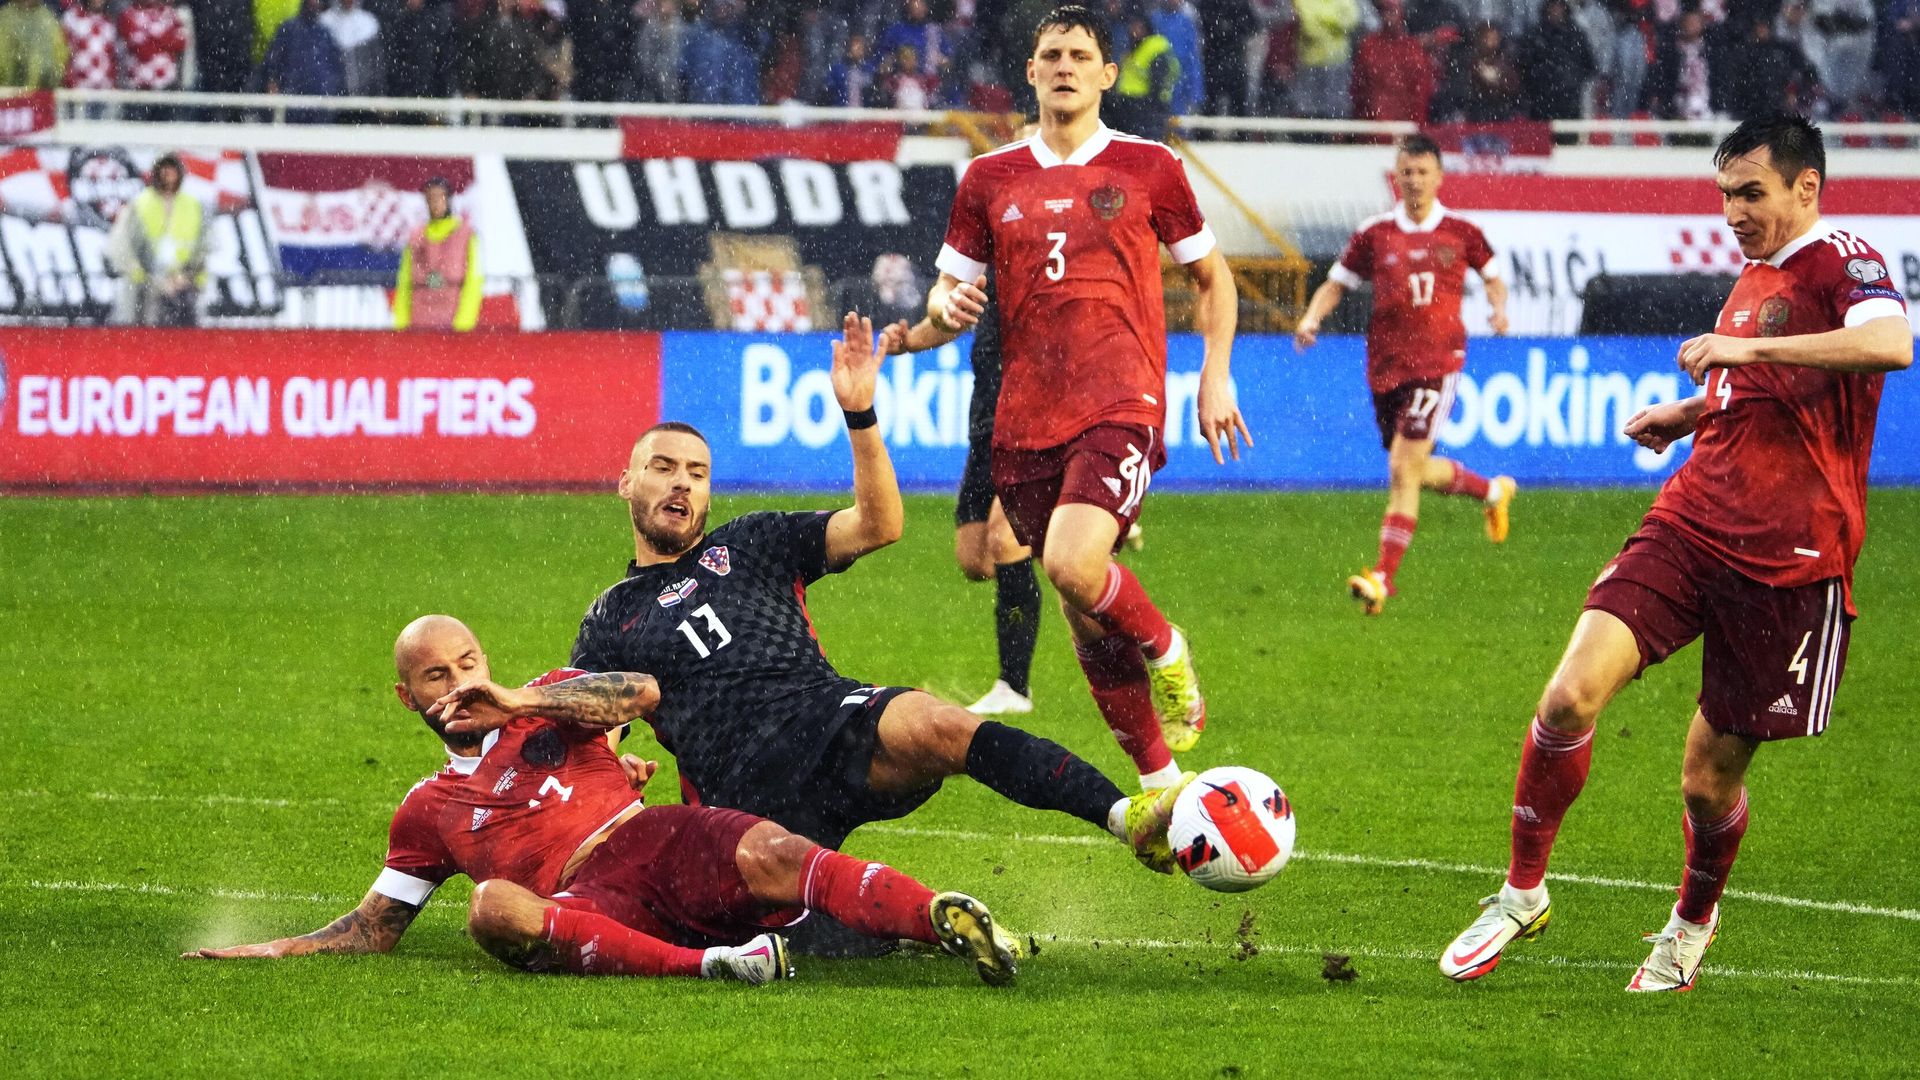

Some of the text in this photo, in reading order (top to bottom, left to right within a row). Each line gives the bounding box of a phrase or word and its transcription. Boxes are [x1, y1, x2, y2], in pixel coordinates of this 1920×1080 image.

[1045, 232, 1067, 281] 3
[1408, 271, 1436, 306] 17
[1864, 288, 1904, 299] RESPECT
[18, 375, 538, 437] EUROPEAN QUALIFIERS
[1408, 388, 1441, 419] 17
[1715, 367, 1733, 411] 4
[676, 602, 733, 659] 13
[1787, 630, 1813, 685] 4
[1768, 704, 1798, 716] adidas
[471, 808, 493, 831] adidas
